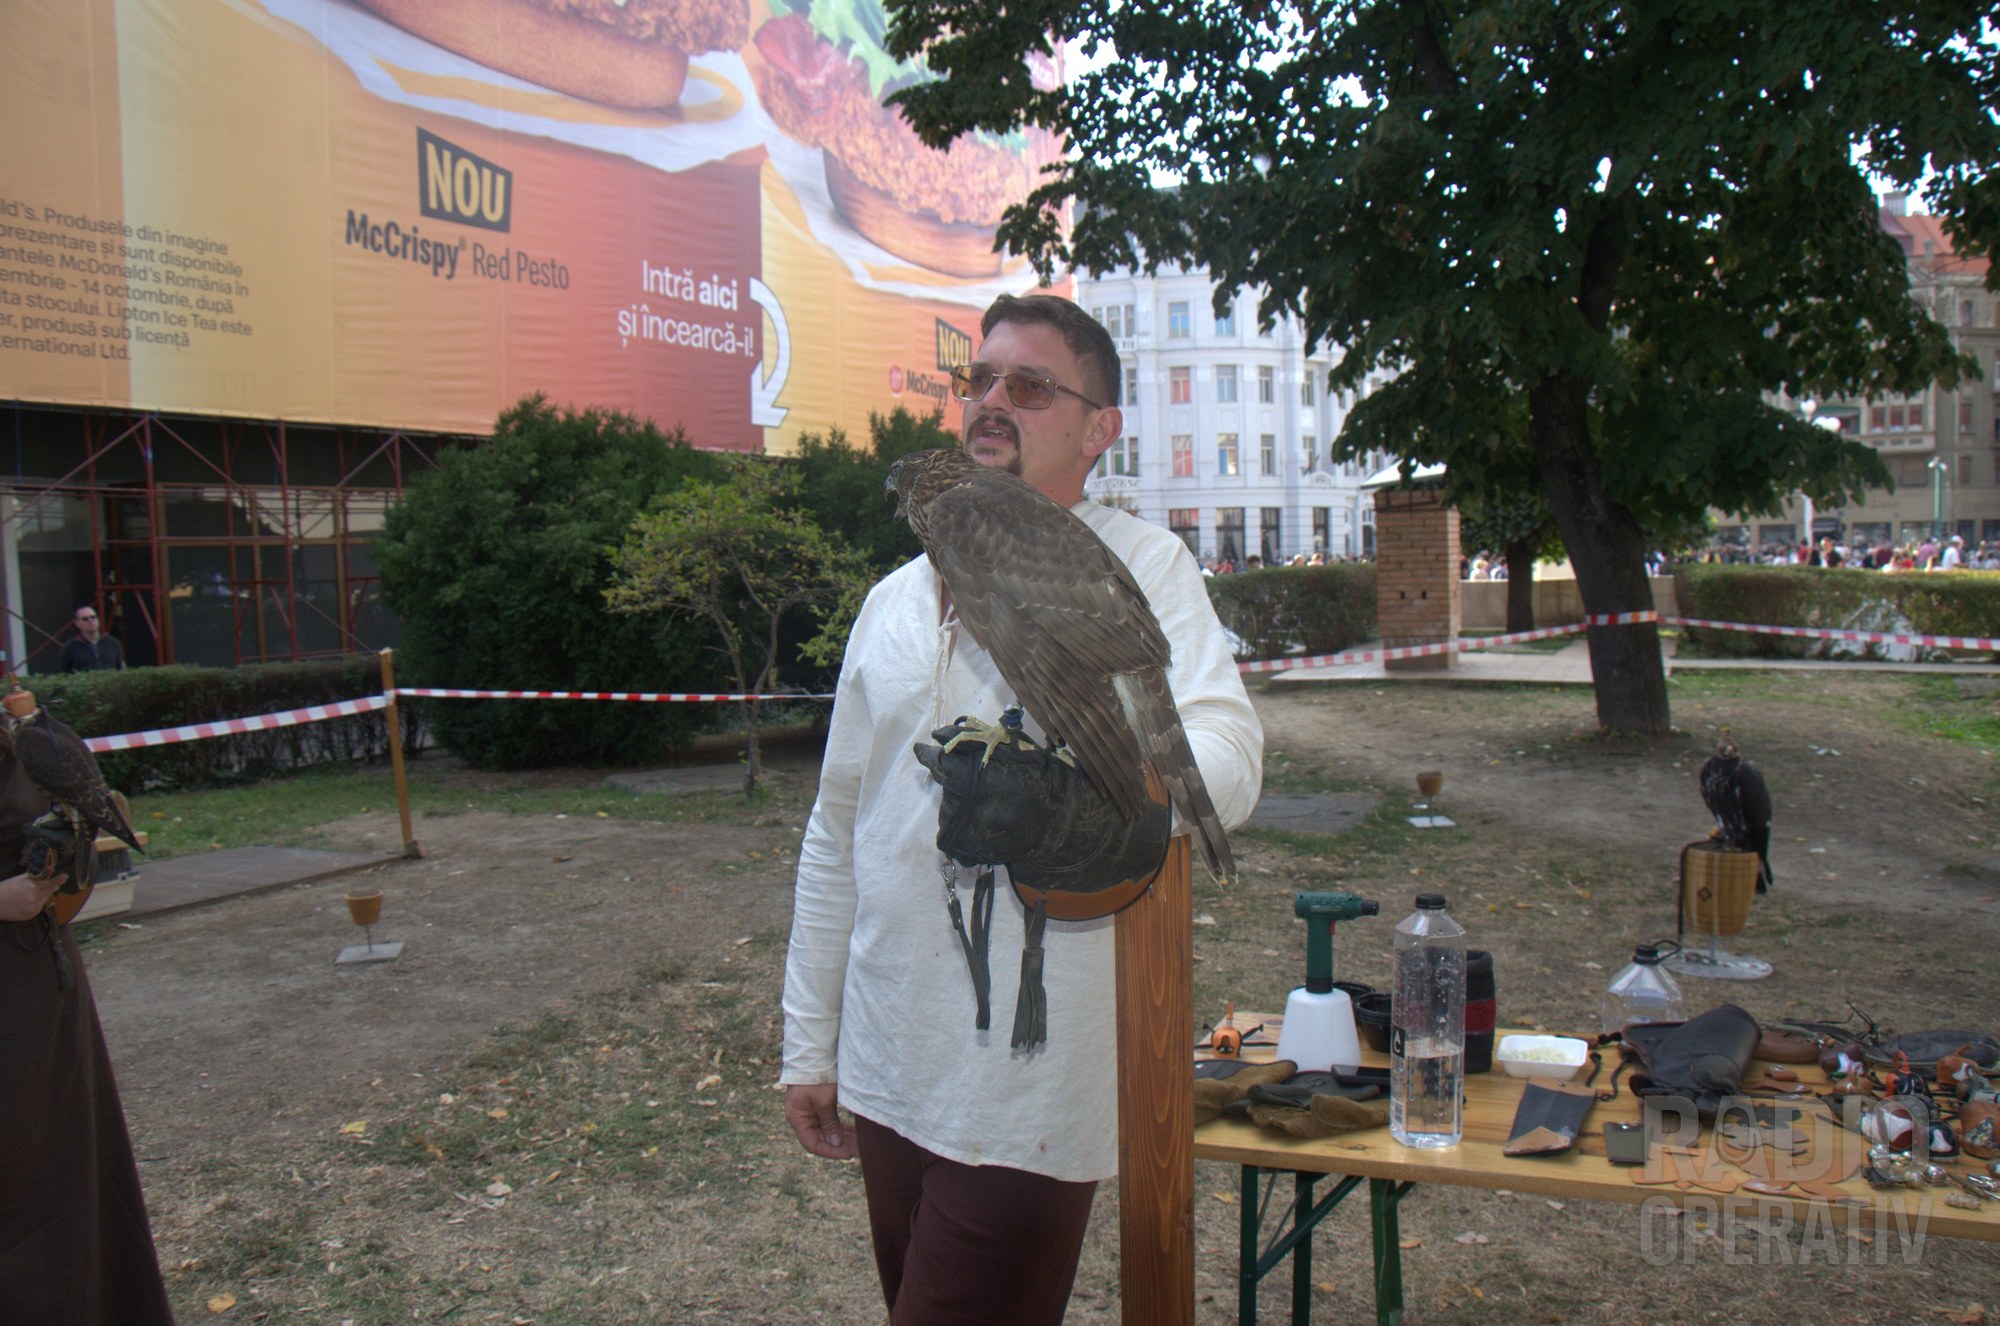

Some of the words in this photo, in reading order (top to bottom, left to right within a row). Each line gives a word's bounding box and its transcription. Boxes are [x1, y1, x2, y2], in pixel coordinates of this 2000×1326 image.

[426, 141, 506, 223] NOU
[43, 207, 133, 238] Produsele
[136, 225, 163, 243] din
[166, 229, 228, 255] imagine
[119, 245, 156, 263] sunt
[159, 249, 243, 278] disponibile
[165, 270, 232, 295] România
[472, 242, 511, 281] Red
[516, 251, 570, 290] Pesto
[81, 279, 101, 295] 14
[103, 284, 193, 310] octombrie,
[195, 295, 234, 316] după
[642, 259, 695, 302] Intră
[698, 272, 738, 312] aici
[22, 316, 97, 338] produsă
[101, 324, 132, 341] sub
[26, 293, 103, 317] stocului.
[107, 301, 160, 324] Lipton
[163, 310, 188, 327] Ice
[190, 313, 218, 332] Tea
[220, 320, 253, 337] este
[617, 303, 638, 349] și
[640, 303, 754, 358] încearcă-i!
[100, 343, 131, 361] Ltd.
[938, 324, 970, 367] NOU
